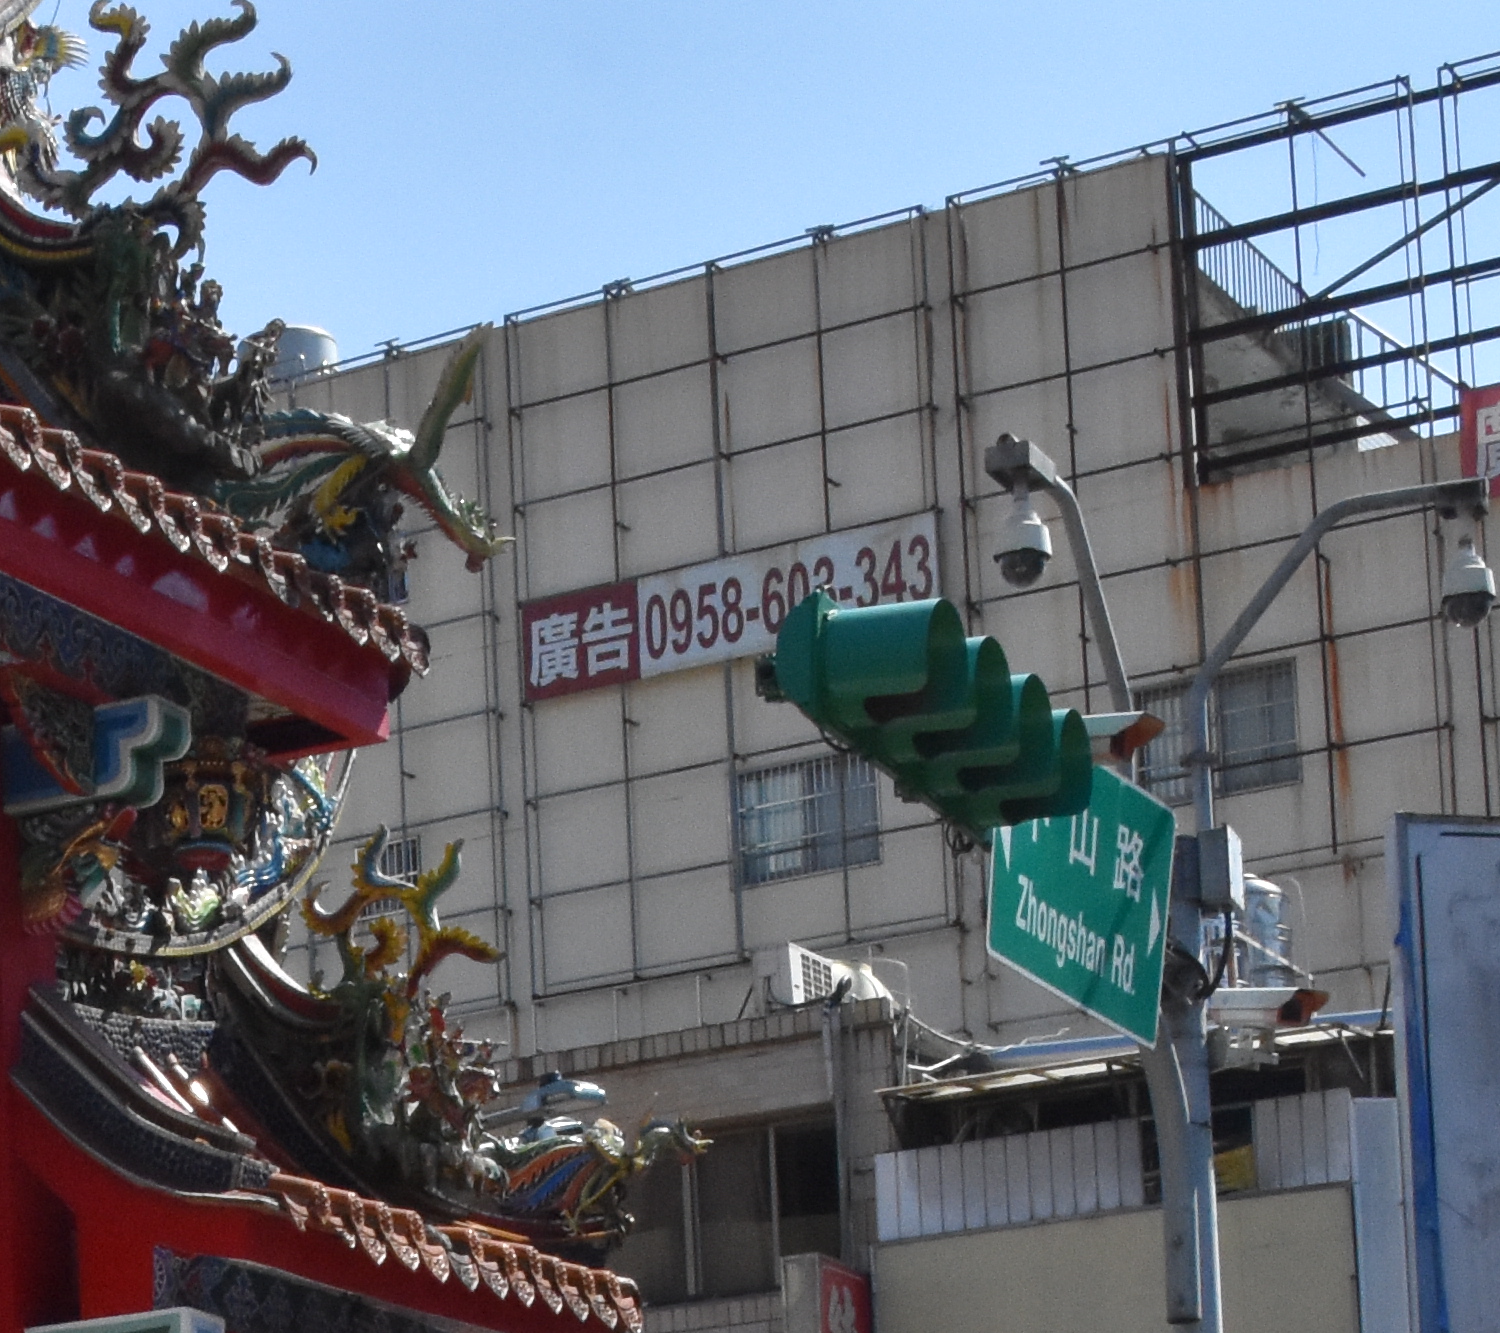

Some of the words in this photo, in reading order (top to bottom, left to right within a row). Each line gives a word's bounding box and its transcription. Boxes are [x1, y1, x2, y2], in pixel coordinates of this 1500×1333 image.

[529, 602, 633, 688] 廣告
[1031, 808, 1144, 903] 山路
[1015, 873, 1107, 978] Zhongshan
[1111, 933, 1136, 996] Rd.
